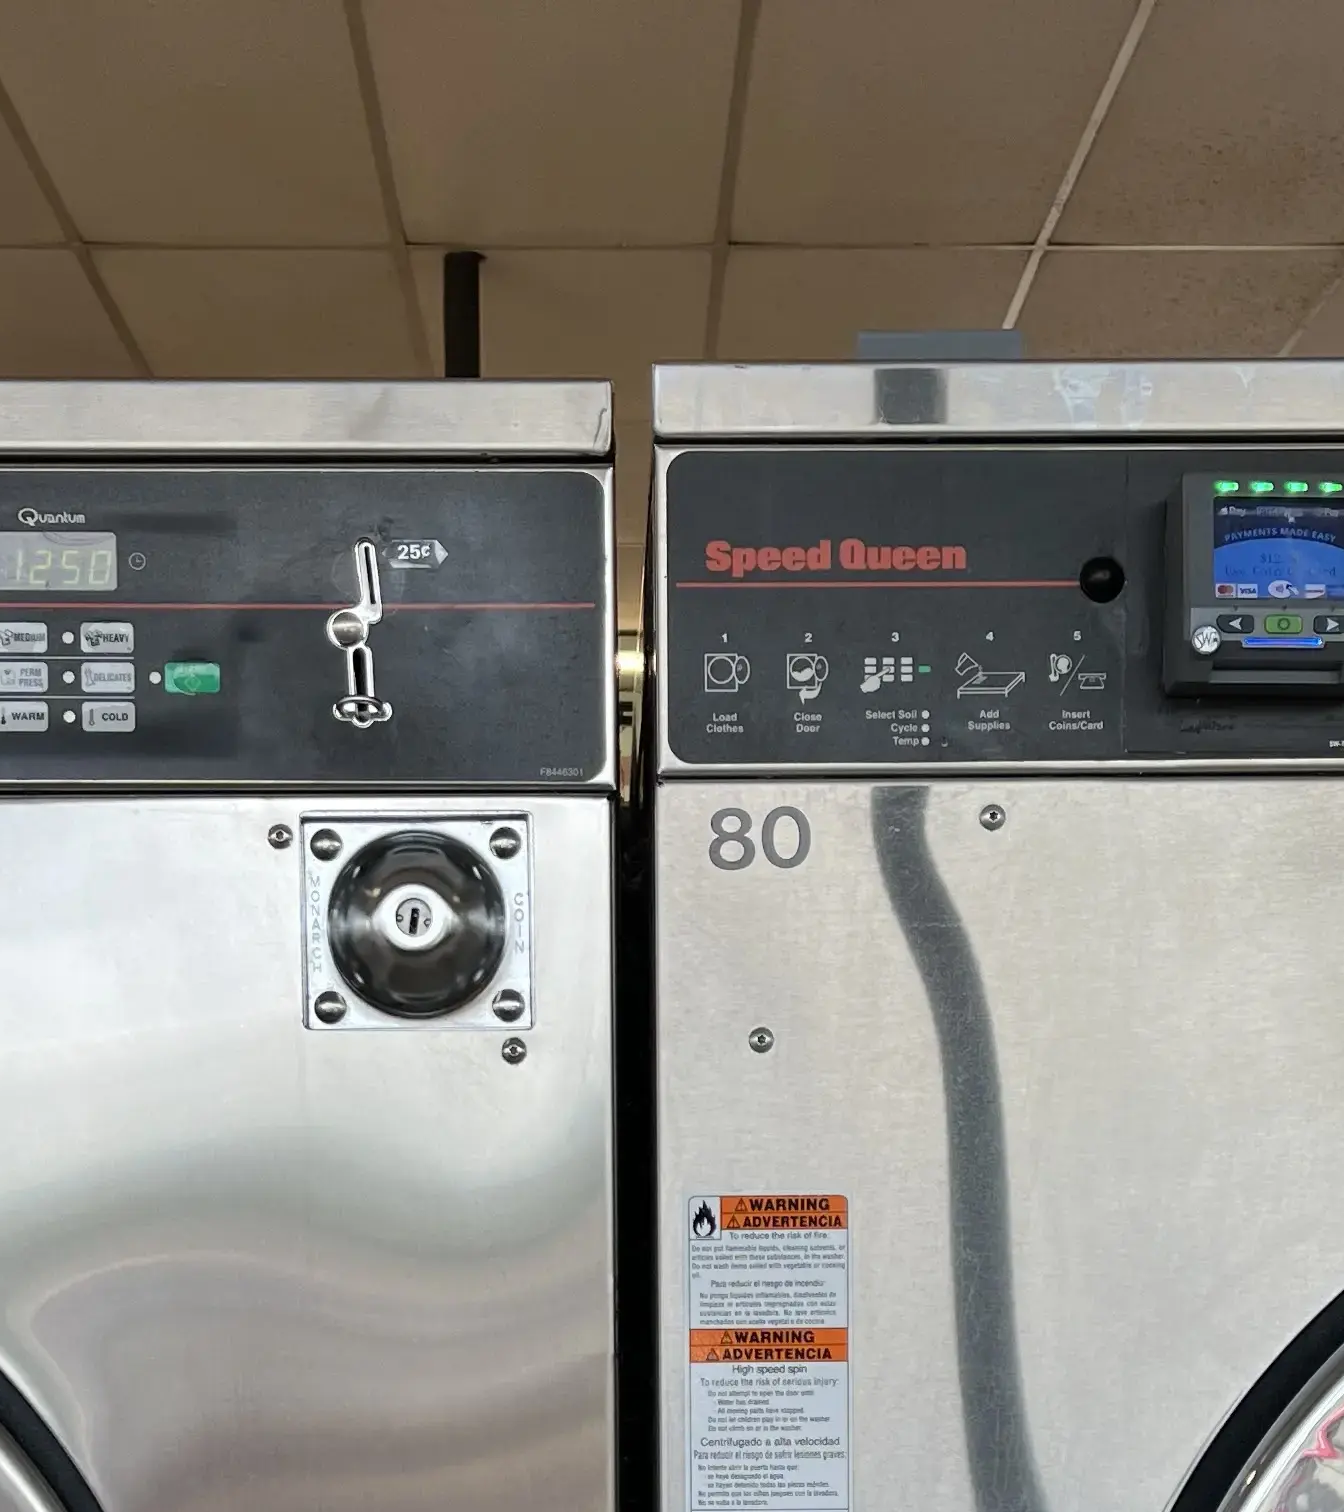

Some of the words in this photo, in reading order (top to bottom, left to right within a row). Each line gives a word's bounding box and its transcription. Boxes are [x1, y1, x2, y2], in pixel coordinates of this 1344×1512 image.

[17, 507, 86, 526] Quantum
[1224, 527, 1278, 541] PAYMENTS
[1280, 527, 1308, 537] MADE
[1311, 530, 1337, 542] EASY
[397, 543, 431, 560] 25¢
[705, 539, 831, 577] Speed
[839, 538, 966, 570] Queen
[15, 549, 112, 585] 1250
[13, 632, 46, 642] MEDIUM
[102, 633, 130, 643] HEAVY
[721, 633, 728, 643] 1
[804, 633, 813, 643] 2
[891, 632, 900, 642] 3
[985, 631, 994, 641] 4
[1073, 631, 1082, 641] 5
[19, 668, 42, 677] PERM
[94, 673, 132, 682] DELICATES
[18, 679, 43, 687] PRESS
[11, 712, 45, 720] WARM
[101, 712, 129, 721] COLD
[712, 713, 738, 722] Load
[793, 712, 822, 722] Close
[865, 710, 895, 719] Select
[898, 710, 918, 719] Soil
[979, 709, 1000, 719] Add
[1062, 709, 1091, 719] Insert
[706, 723, 744, 733] Clothes
[796, 724, 820, 733] Door
[890, 723, 918, 734] Cycle
[967, 720, 1011, 732] Supplies
[1048, 720, 1104, 731] Coins/Card
[892, 736, 919, 747] Temp
[709, 805, 811, 870] 80
[310, 875, 322, 973] MONARCH
[514, 892, 525, 954] COIN
[749, 1198, 830, 1211] WARNING
[742, 1215, 842, 1228] ADVERTENCIA
[734, 1330, 815, 1343] WARNING
[722, 1348, 832, 1360] ADVERTENCIA
[732, 1365, 754, 1376] High
[756, 1365, 786, 1377] speed
[787, 1365, 808, 1376] spin
[700, 1437, 763, 1448] Centrifugado
[765, 1439, 772, 1447] a
[774, 1437, 792, 1446] alta
[794, 1436, 840, 1446] velocidad
